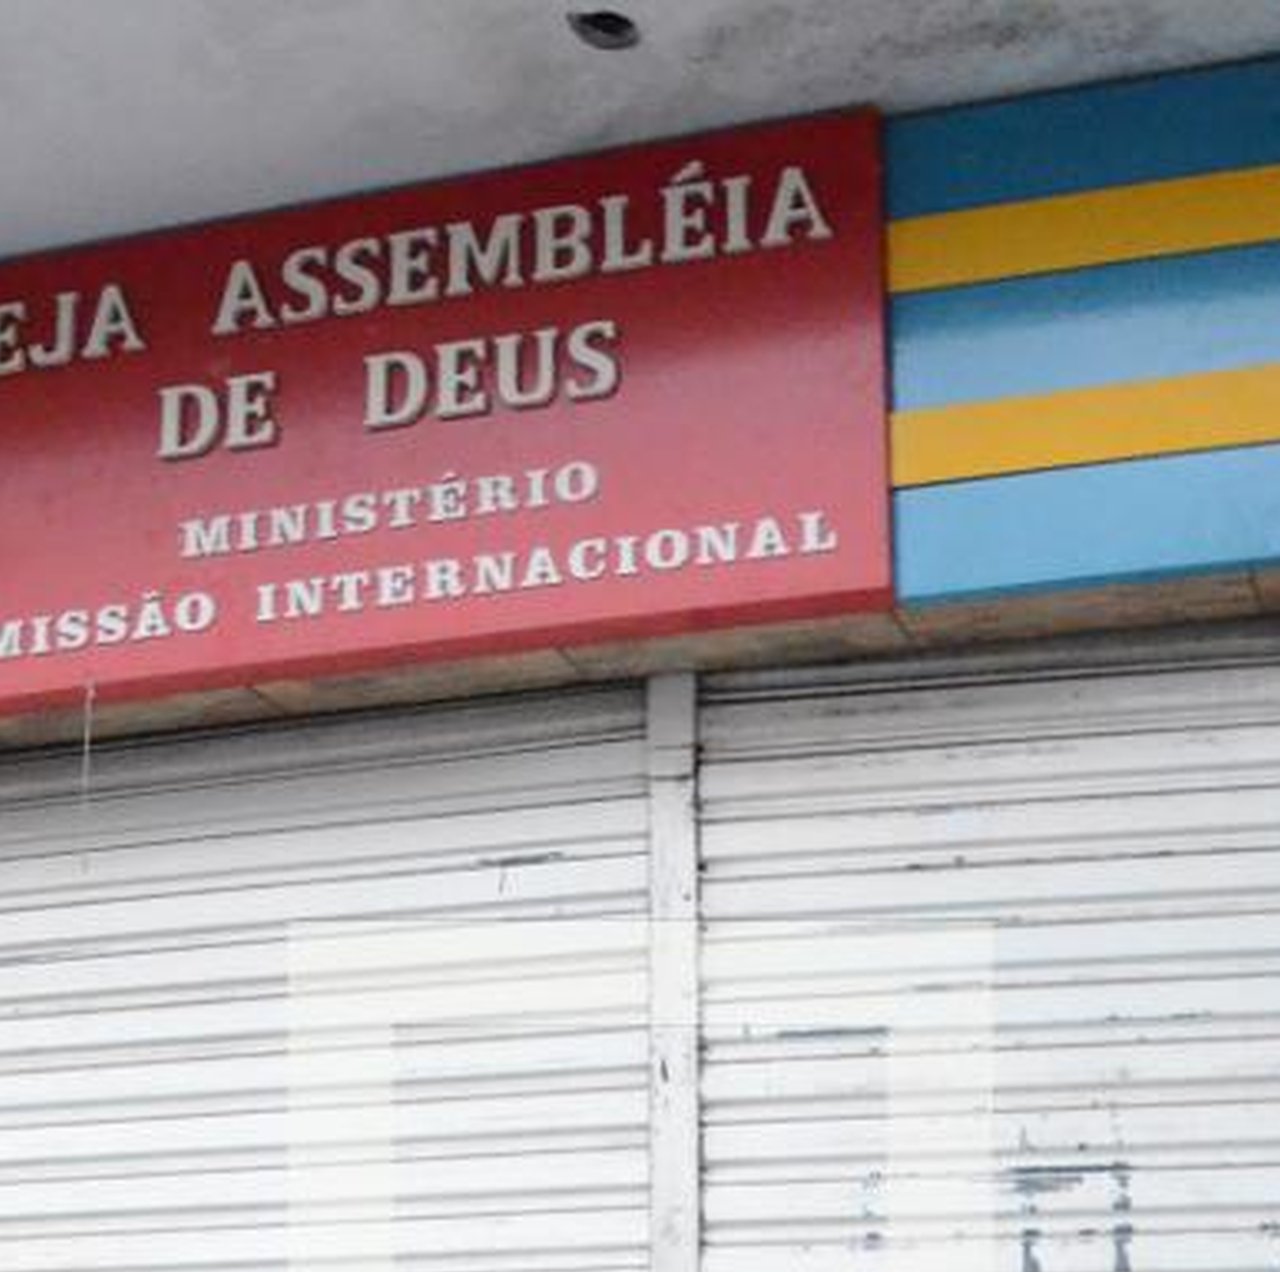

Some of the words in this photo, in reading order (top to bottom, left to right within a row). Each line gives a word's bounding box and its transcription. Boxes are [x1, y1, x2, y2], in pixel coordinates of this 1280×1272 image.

[212, 160, 833, 334] ASSEMBLÉIA
[156, 370, 277, 458] DE
[363, 320, 618, 429] DEUS
[179, 461, 597, 557] MINISTÉRIO
[256, 510, 837, 623] INTERNACIONAL
